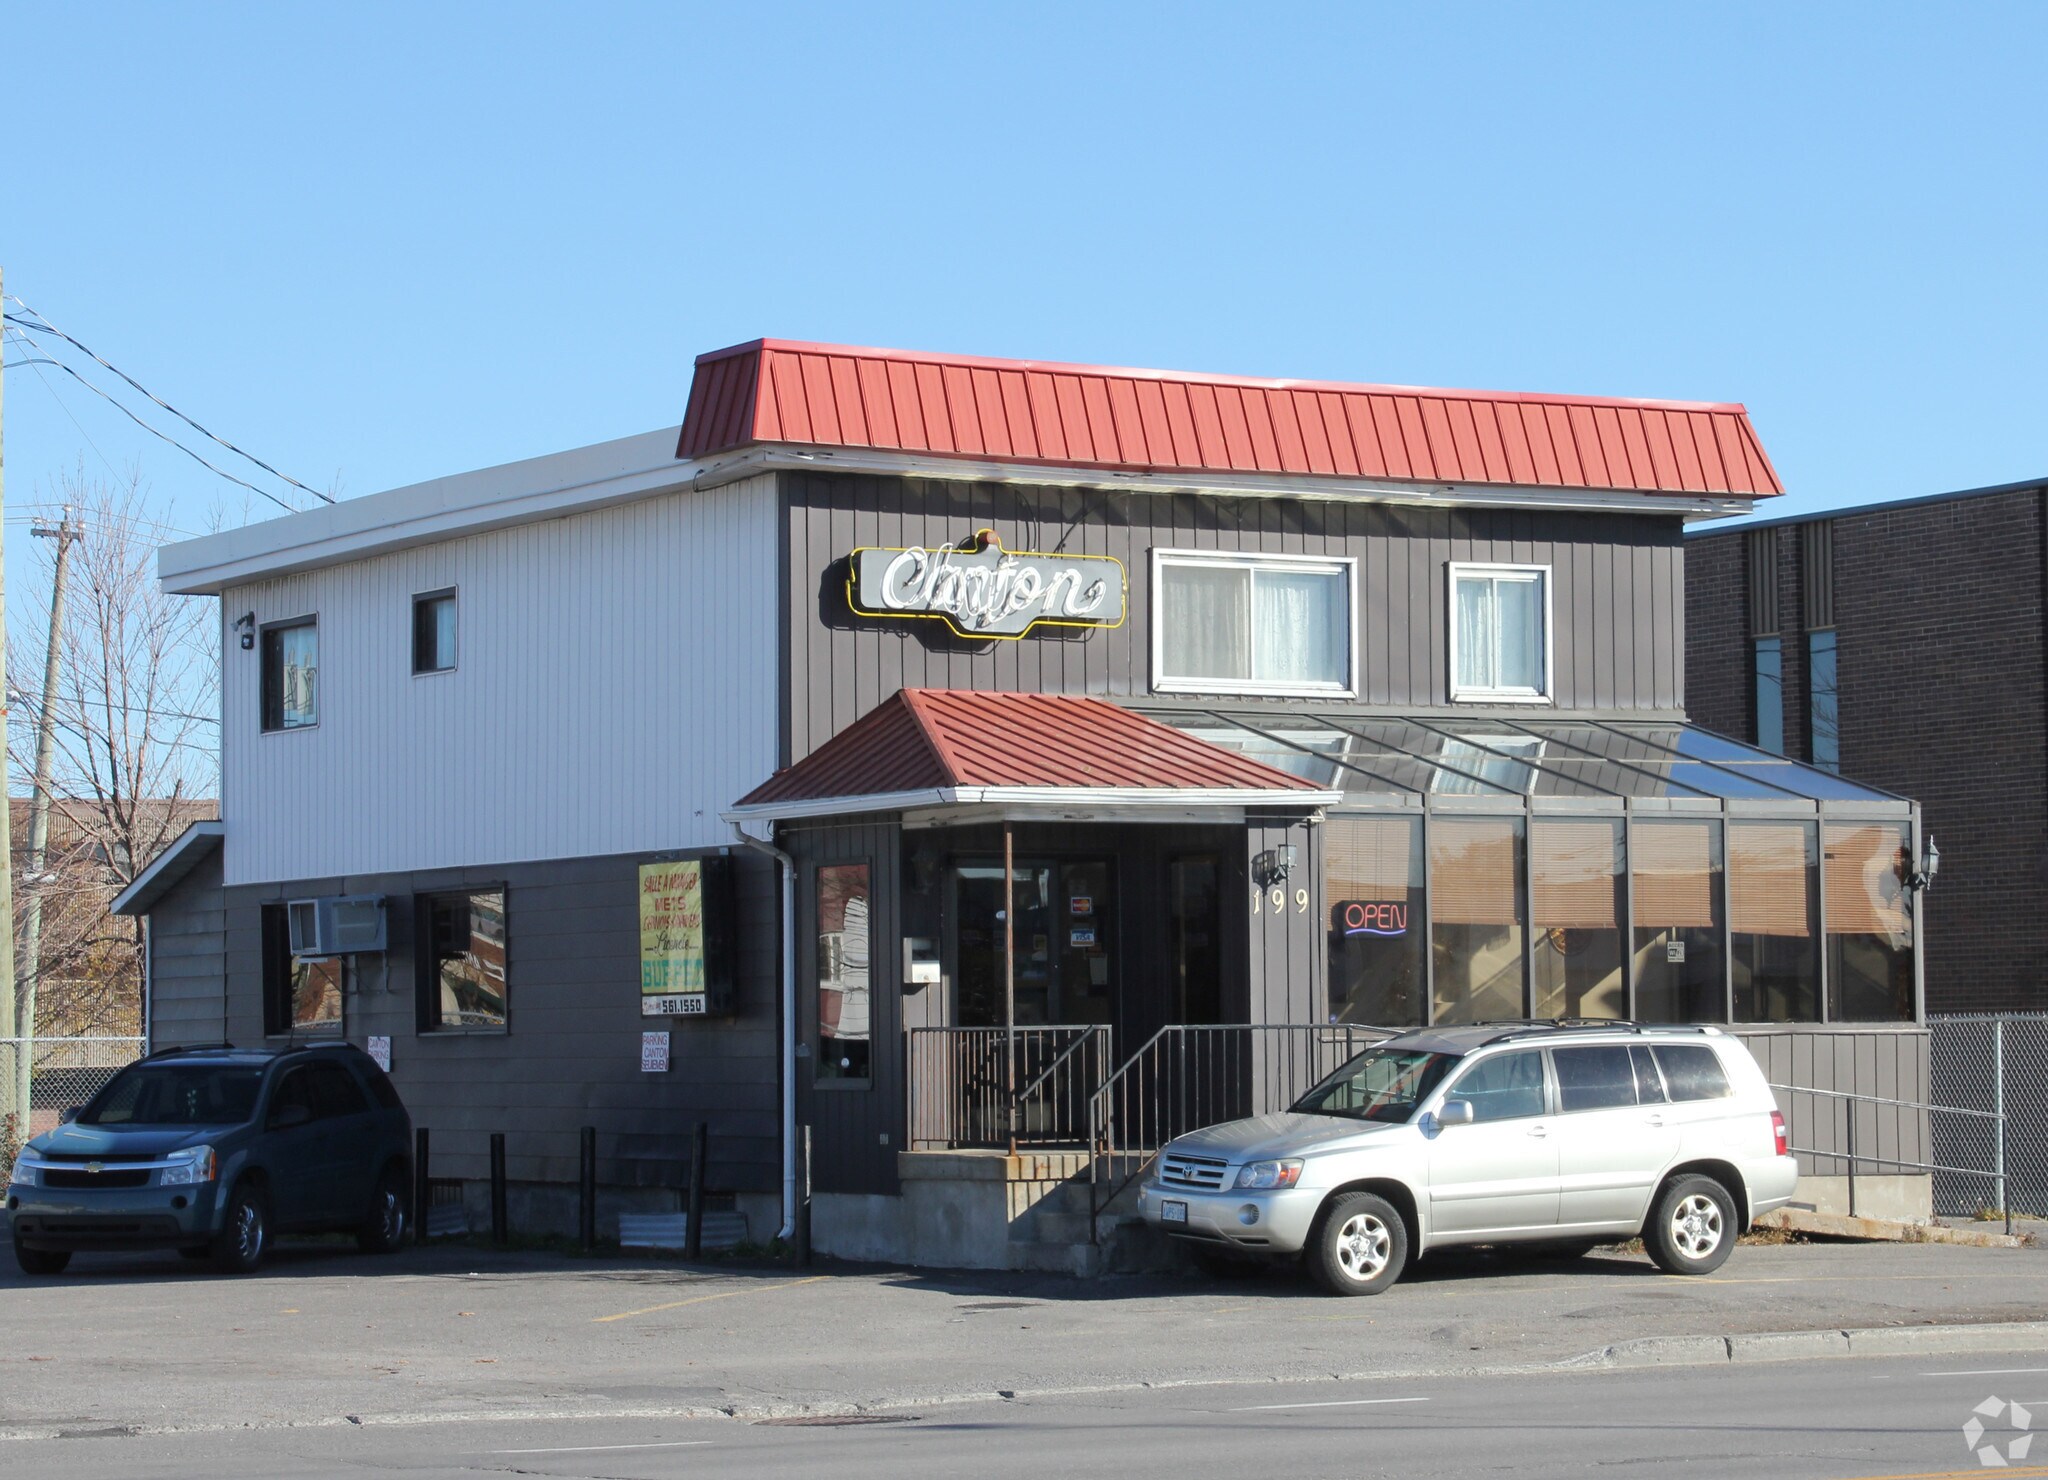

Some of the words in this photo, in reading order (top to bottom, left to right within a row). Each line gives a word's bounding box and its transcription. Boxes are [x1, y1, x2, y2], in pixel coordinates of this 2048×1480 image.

[1253, 888, 1308, 914] 199
[1345, 903, 1407, 929] OPEN
[662, 998, 702, 1013] 561.1550
